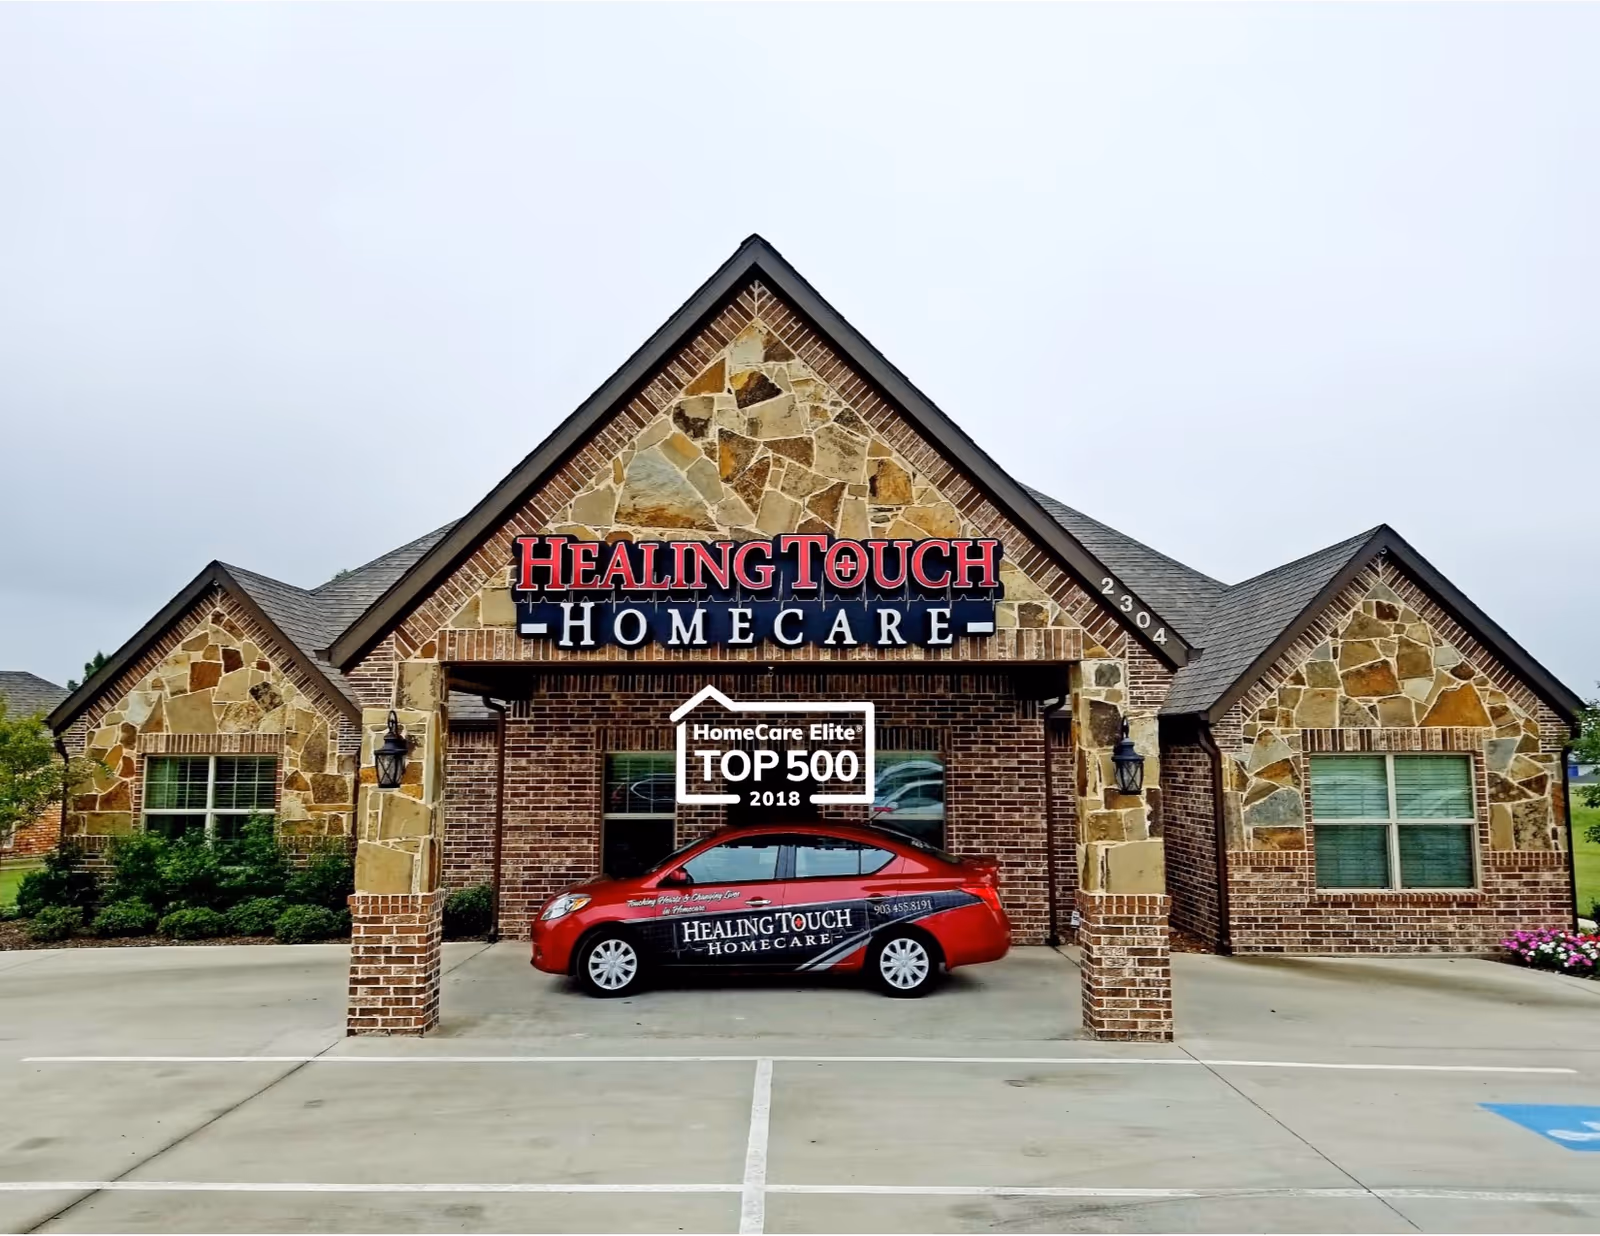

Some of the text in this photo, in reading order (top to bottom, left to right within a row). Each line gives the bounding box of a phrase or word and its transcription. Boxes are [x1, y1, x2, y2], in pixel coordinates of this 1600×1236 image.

[516, 533, 999, 592] HEALING TOUCH
[559, 602, 954, 647] HOMECARE
[1101, 577, 1168, 645] 2304
[627, 899, 657, 907] Touching
[692, 892, 722, 901] Changing
[682, 908, 853, 943] HEALING TOUCH
[707, 933, 832, 956] HOMECARE
